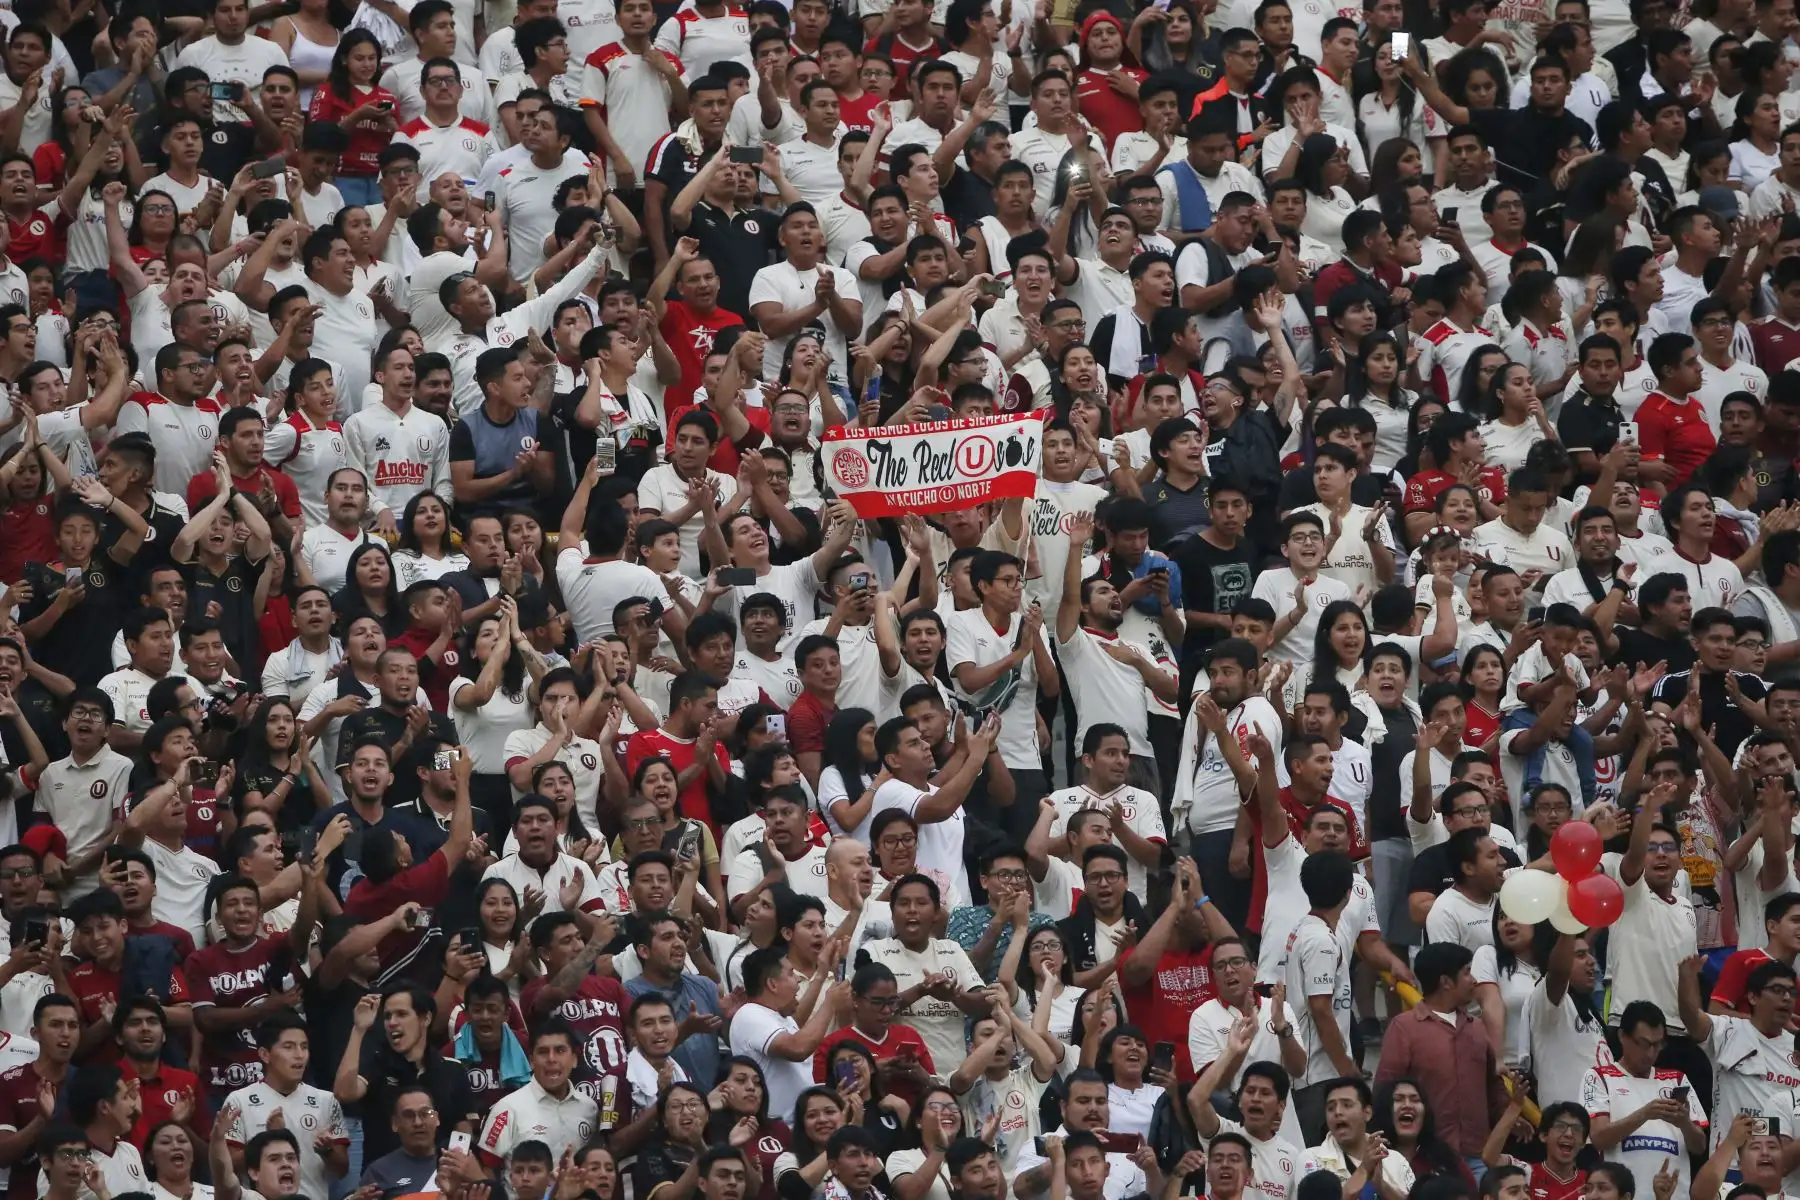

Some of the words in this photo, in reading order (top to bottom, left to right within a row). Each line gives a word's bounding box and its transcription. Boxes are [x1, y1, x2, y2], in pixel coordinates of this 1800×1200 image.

[866, 438, 908, 488] The
[957, 480, 992, 500] NORTE
[1344, 554, 1365, 562] CAJA
[1624, 1138, 1676, 1152] ANYPSA
